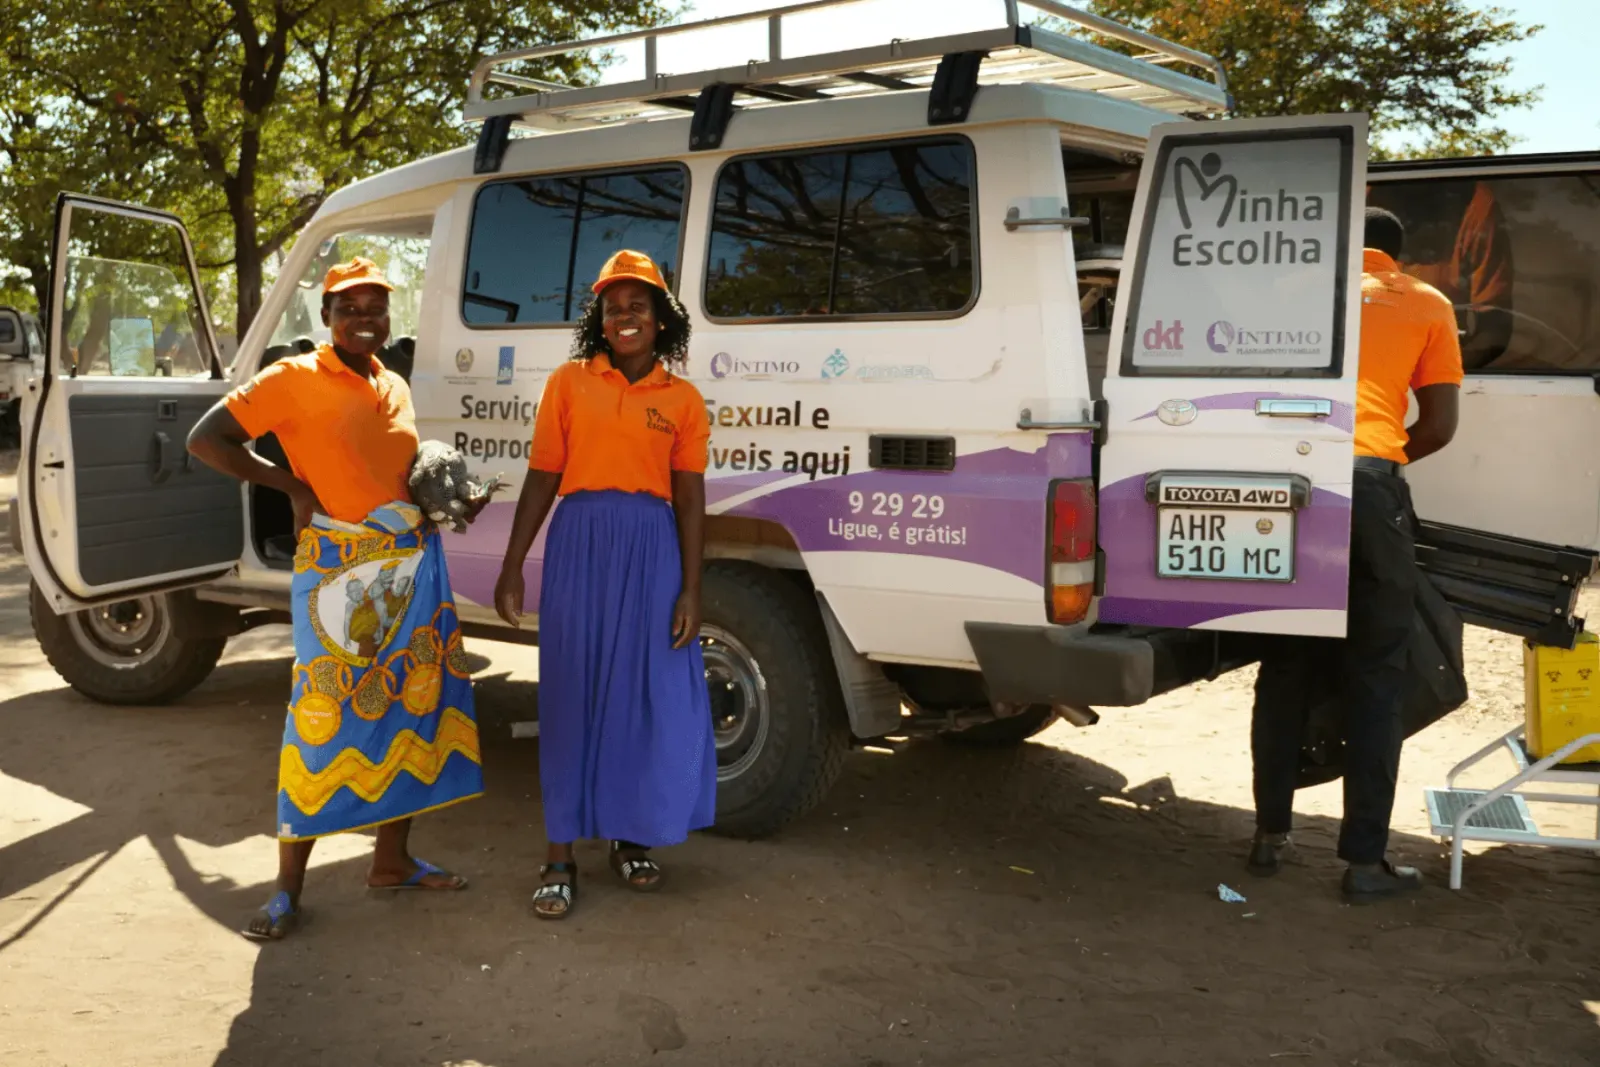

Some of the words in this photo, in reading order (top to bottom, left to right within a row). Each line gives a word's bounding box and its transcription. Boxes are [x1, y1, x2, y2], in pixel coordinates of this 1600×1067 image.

[1174, 153, 1323, 229] Minha
[1172, 231, 1321, 266] Escolha
[1143, 320, 1184, 350] dkt
[1237, 327, 1321, 345] ÍNTIMO
[734, 357, 800, 374] ÍNTIMO
[812, 407, 830, 429] e
[782, 446, 850, 480] aqui
[849, 491, 864, 513] 9
[872, 492, 903, 516] 29
[911, 494, 945, 519] 29
[1168, 488, 1237, 502] TOYOTA
[1242, 490, 1288, 504] 4WD
[828, 518, 883, 541] Ligue,
[888, 522, 900, 540] é
[905, 525, 967, 545] grátis!
[1168, 514, 1226, 541] AHR
[1168, 544, 1225, 572] 510
[1243, 548, 1281, 575] MC
